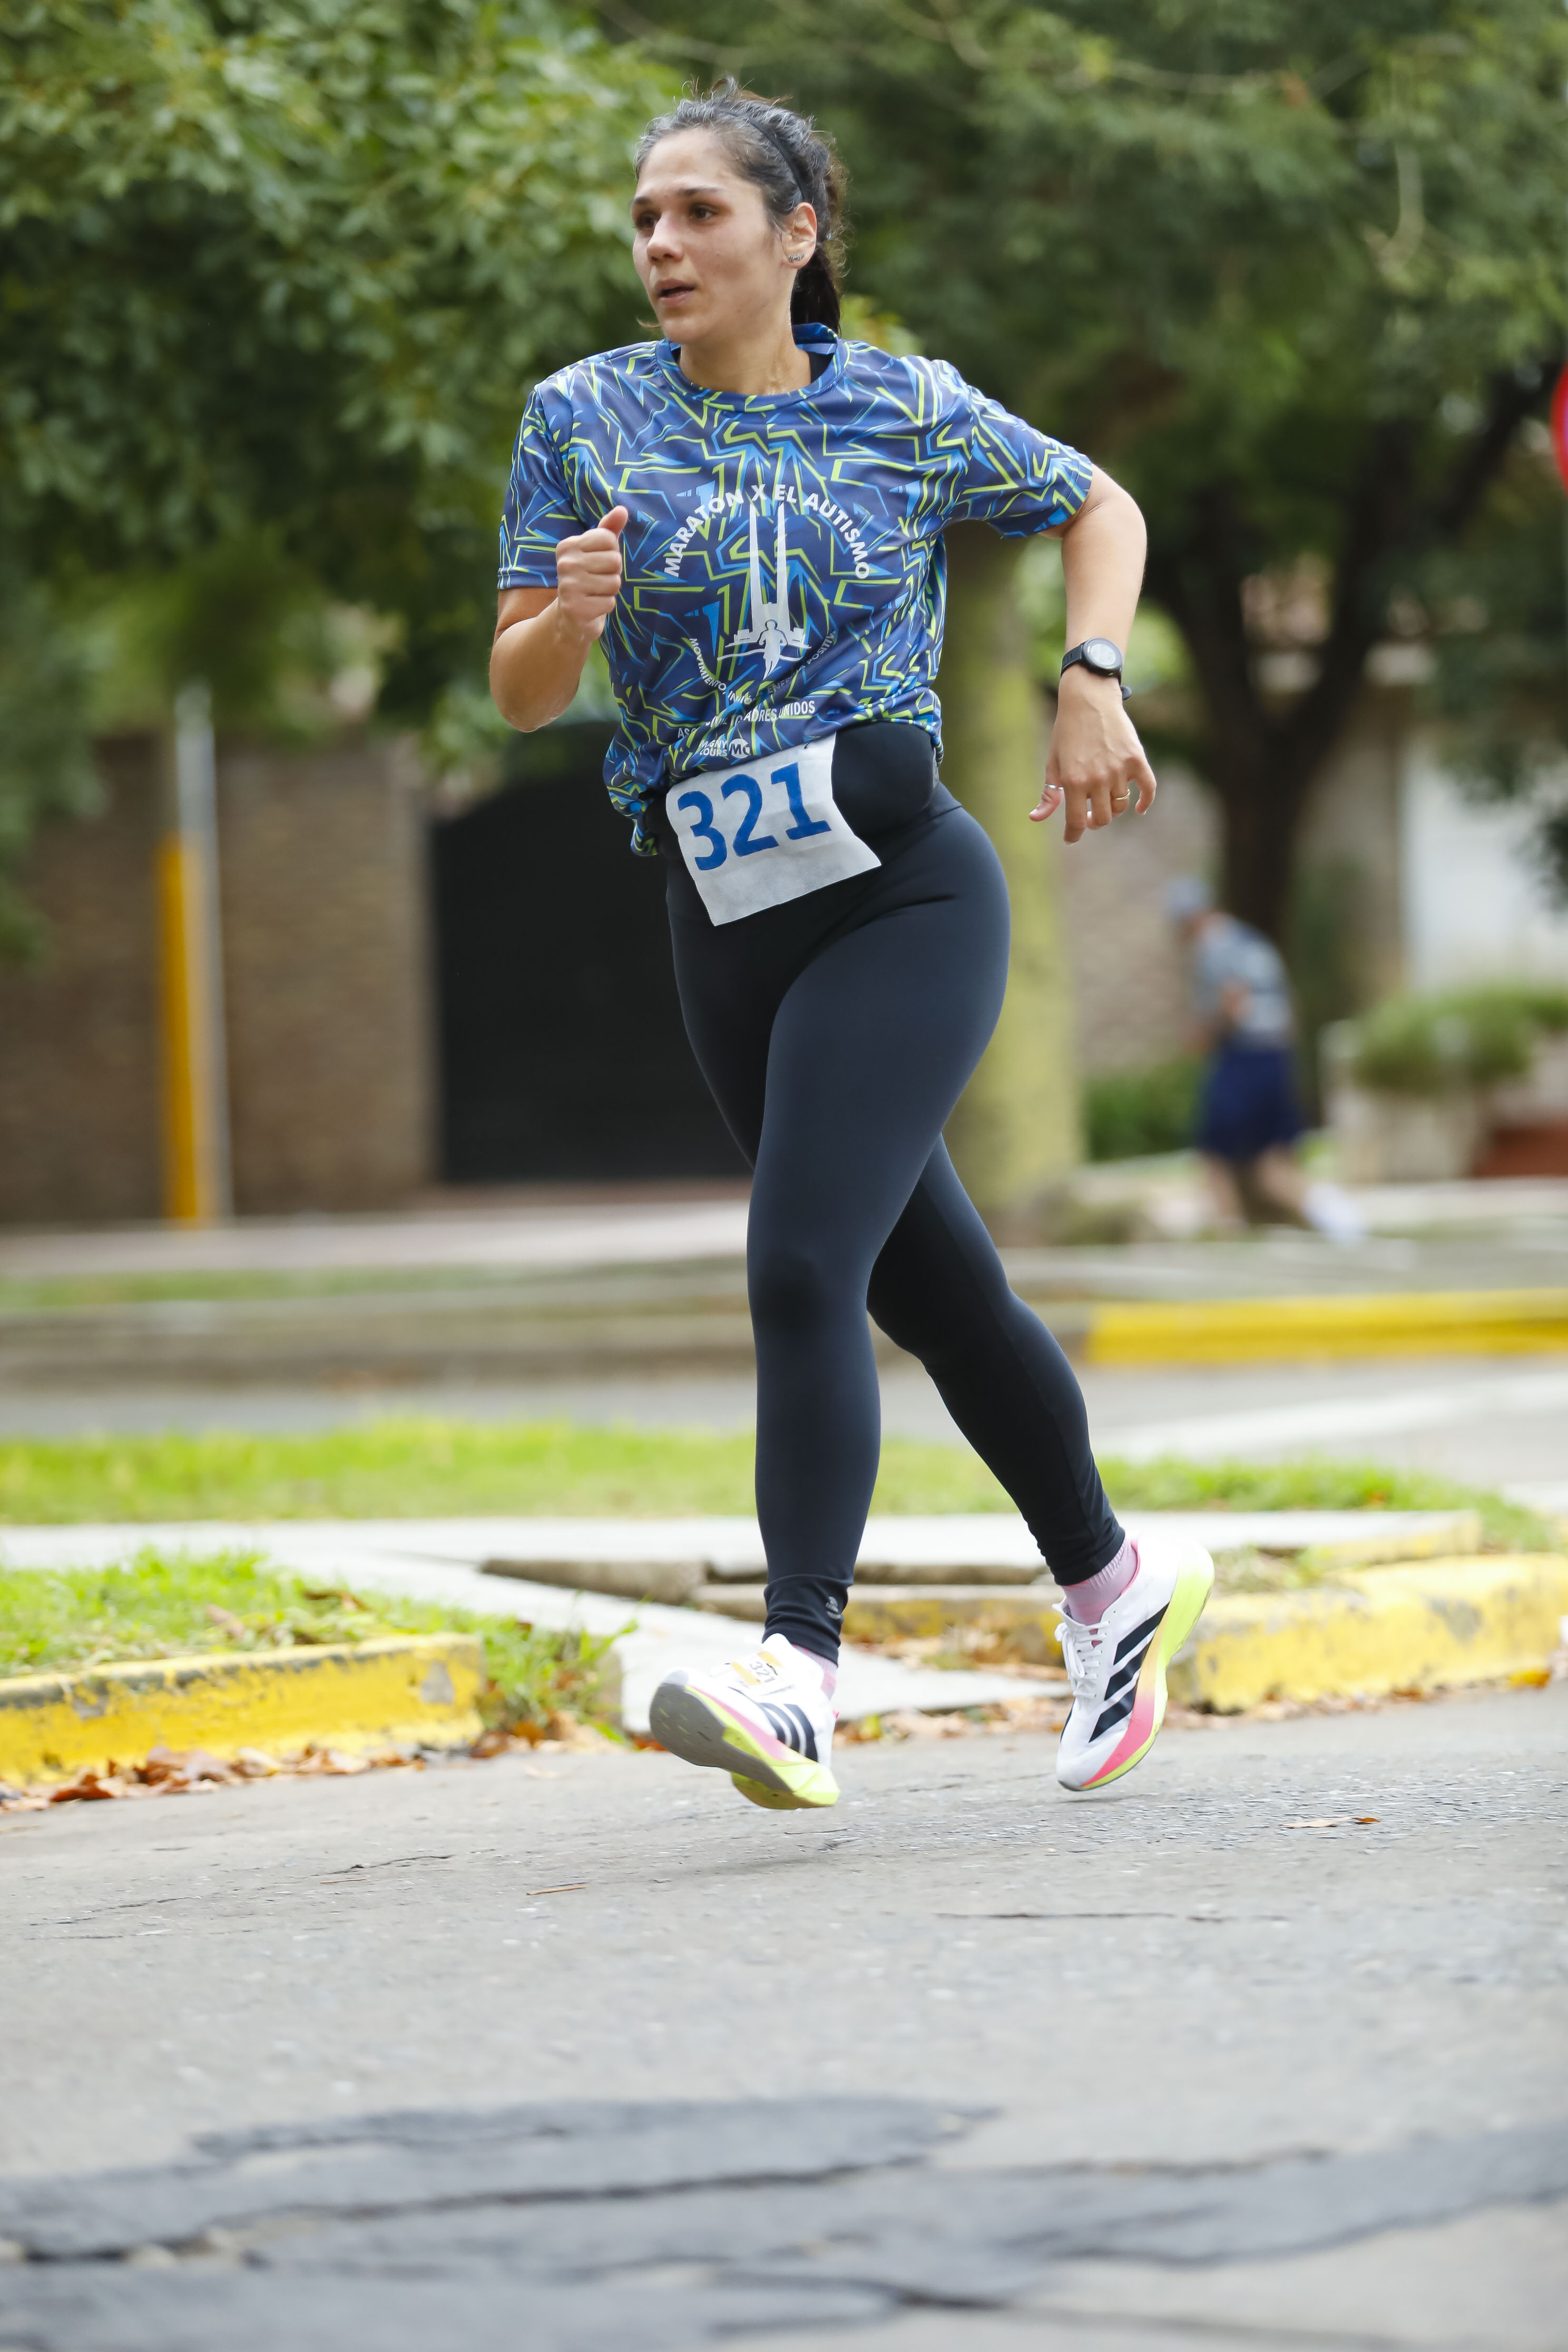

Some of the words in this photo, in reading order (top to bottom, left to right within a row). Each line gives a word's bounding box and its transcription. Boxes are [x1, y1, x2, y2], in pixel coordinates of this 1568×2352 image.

[664, 488, 744, 578] MARATÓN
[750, 484, 767, 501] X
[775, 484, 797, 503] EL
[802, 493, 870, 579] AUTISMO
[743, 708, 778, 722] ADRES
[778, 700, 816, 718] UNIDOS
[677, 762, 832, 871] 321
[749, 1661, 776, 1683] 321
